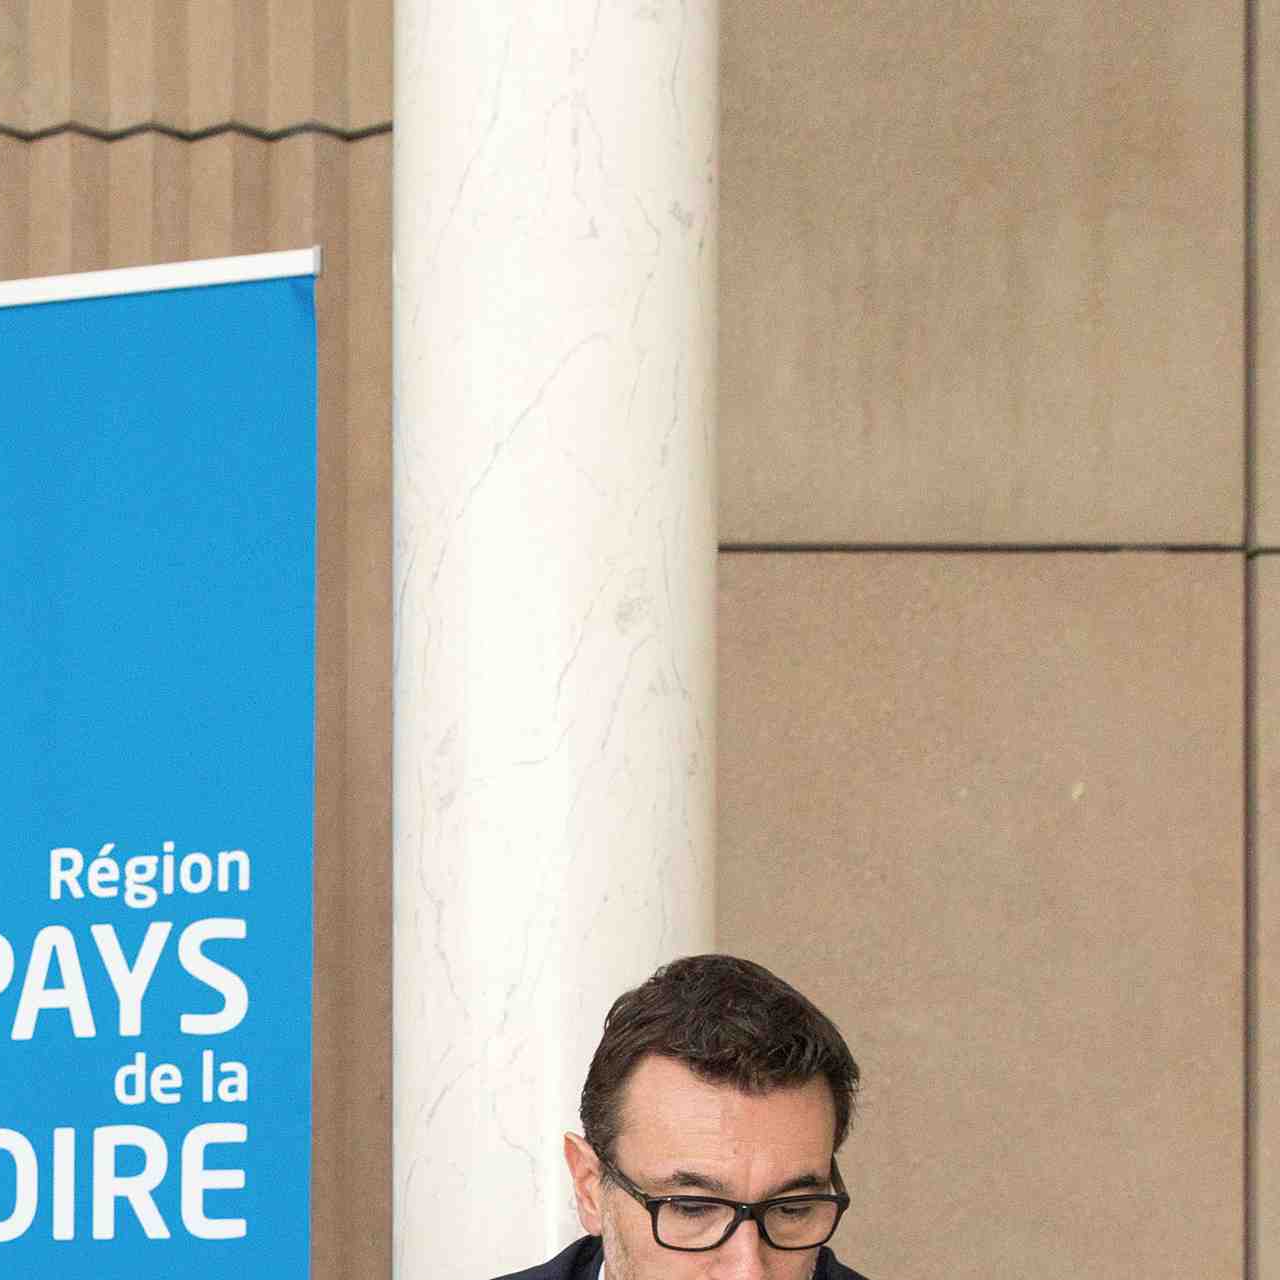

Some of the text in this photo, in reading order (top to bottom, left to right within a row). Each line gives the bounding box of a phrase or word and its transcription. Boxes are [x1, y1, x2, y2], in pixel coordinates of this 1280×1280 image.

[49, 841, 251, 909] Région
[113, 1049, 249, 1105] de la
